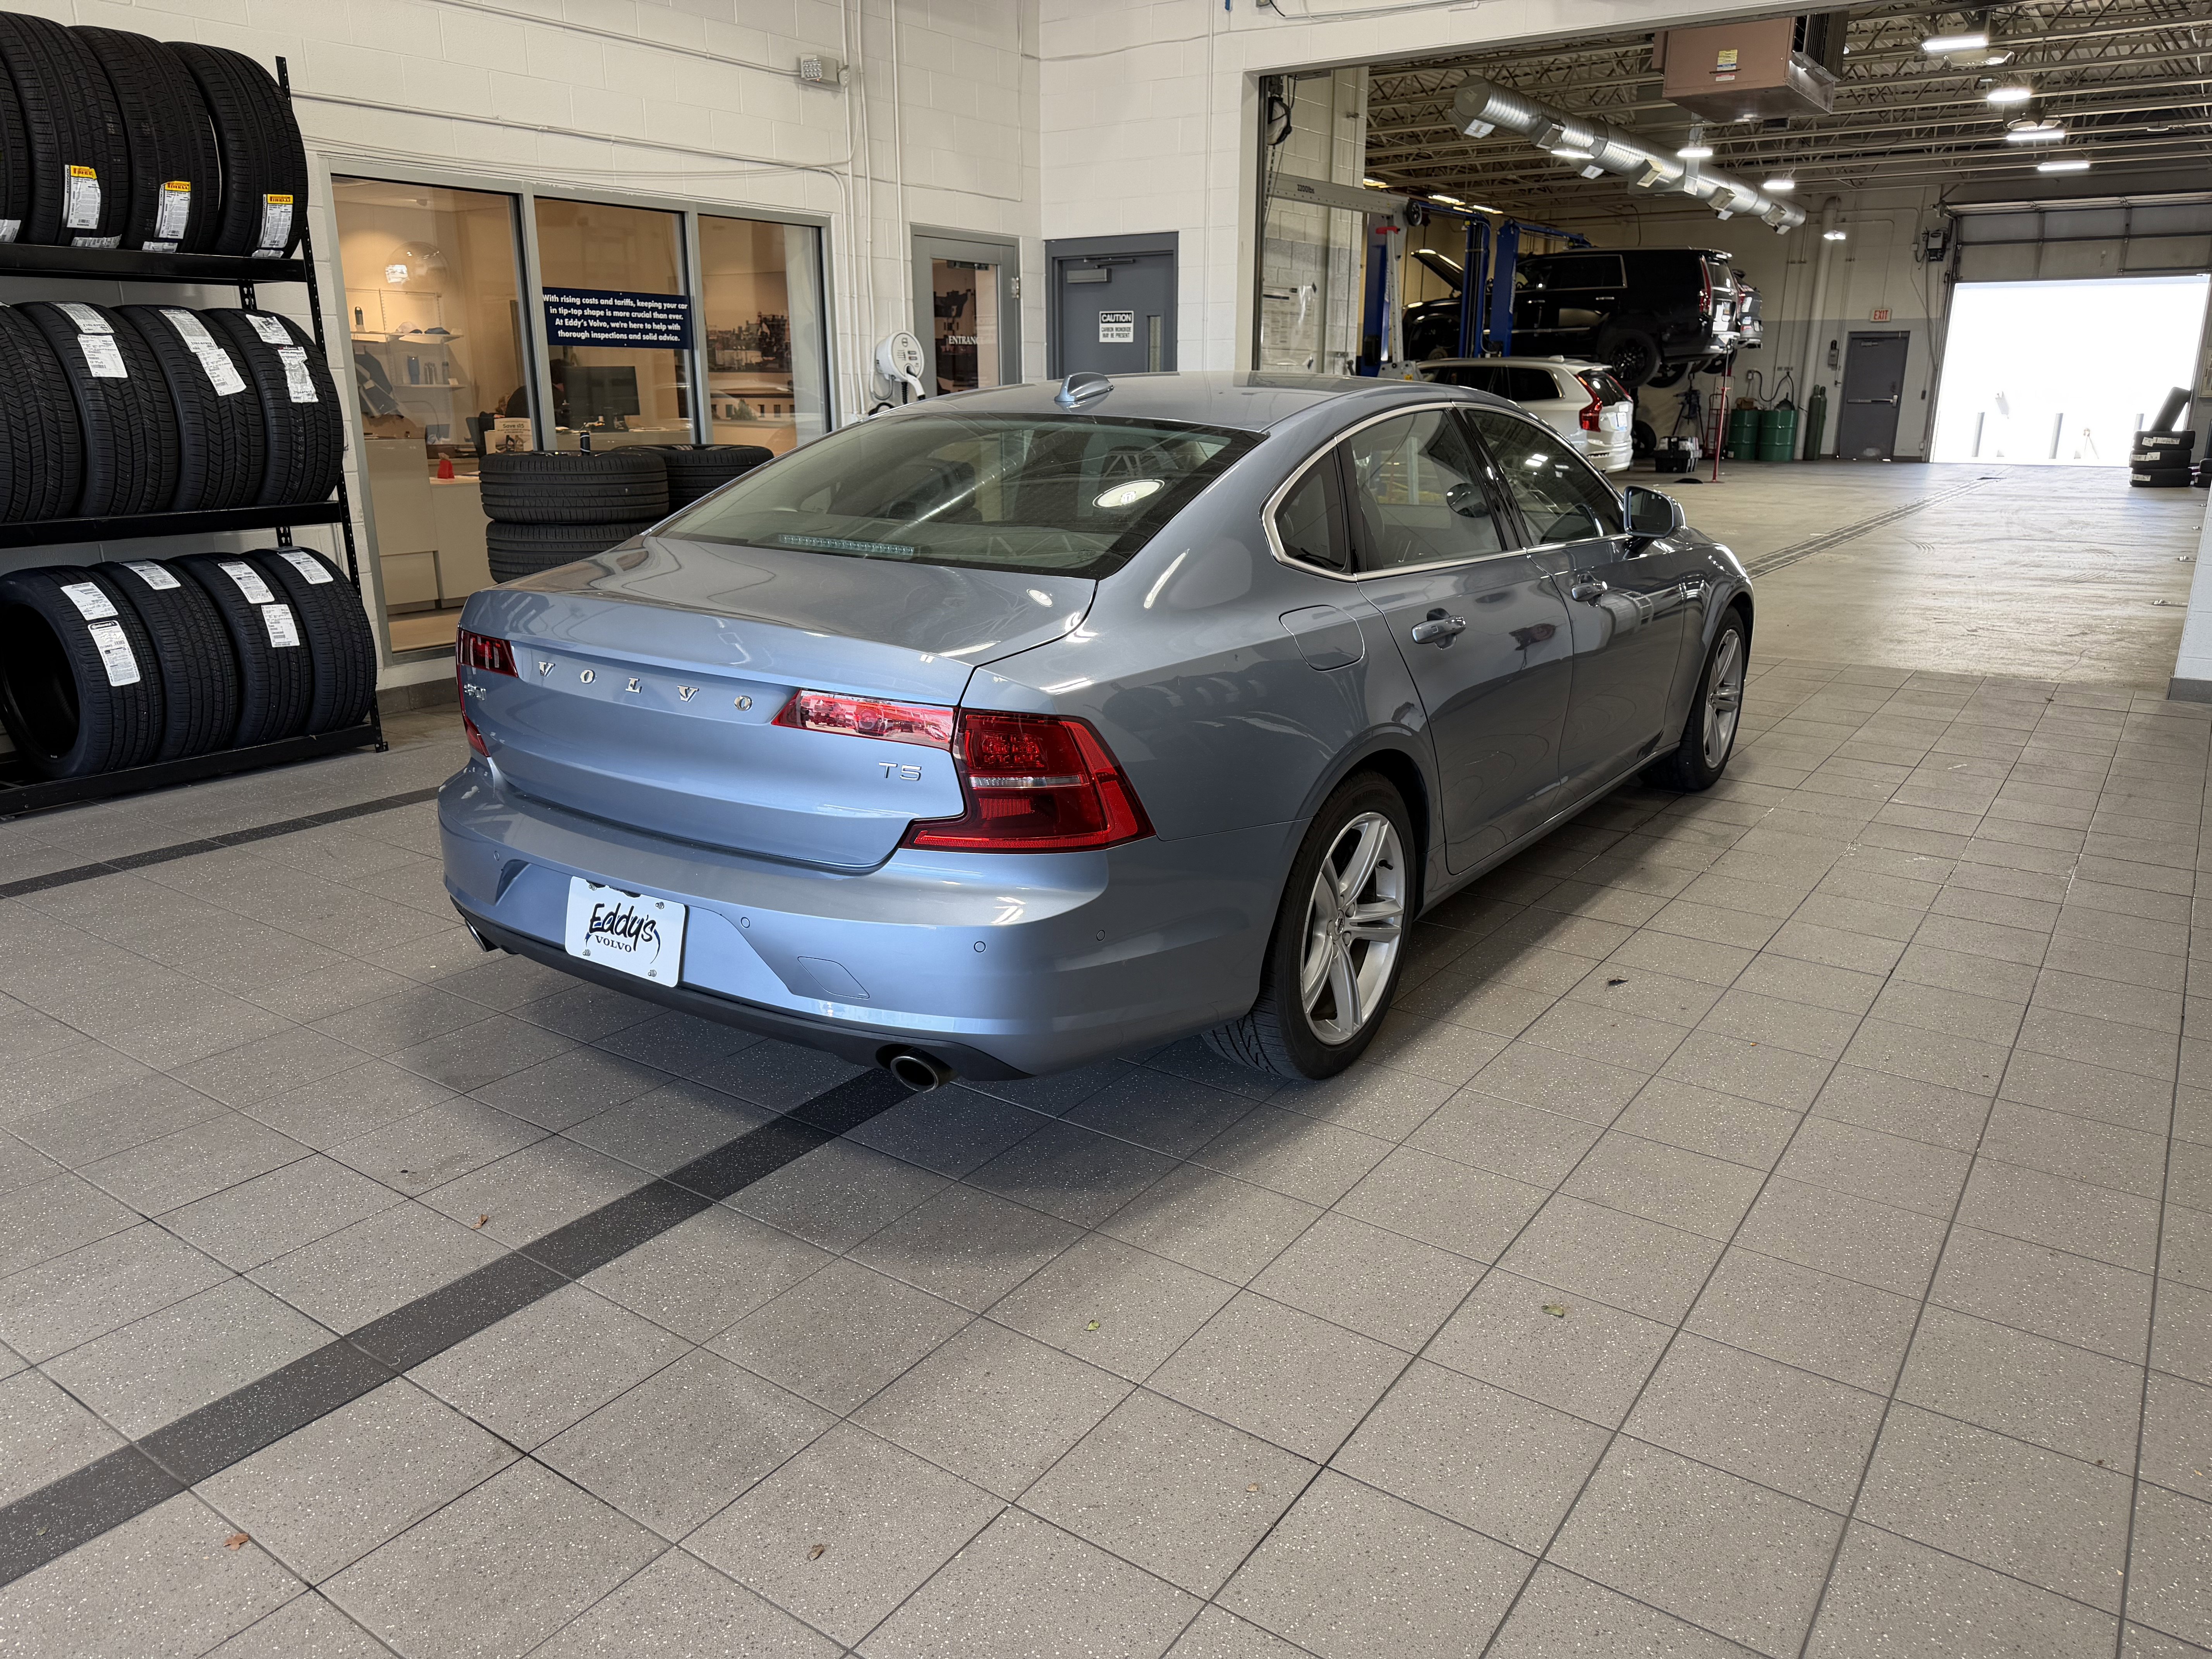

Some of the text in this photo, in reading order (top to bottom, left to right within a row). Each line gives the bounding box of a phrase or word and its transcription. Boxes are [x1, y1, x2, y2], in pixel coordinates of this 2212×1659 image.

[560, 295, 580, 305] rising
[614, 299, 635, 307] tariffs,
[637, 299, 662, 309] keeping
[558, 307, 582, 316] tip-top
[584, 307, 605, 317] shape
[1102, 314, 1131, 322] CAUTION
[1874, 310, 1889, 320] EXIT
[565, 319, 587, 328] Eddy's
[588, 319, 609, 328] Volvo,
[629, 321, 644, 329] here
[653, 322, 666, 331] help
[558, 330, 590, 339] thorough
[591, 331, 627, 340] inspections
[538, 661, 753, 711] VOLVO
[879, 761, 922, 781] T5
[588, 902, 656, 951] Eddy's
[595, 935, 632, 953] VOLVO
